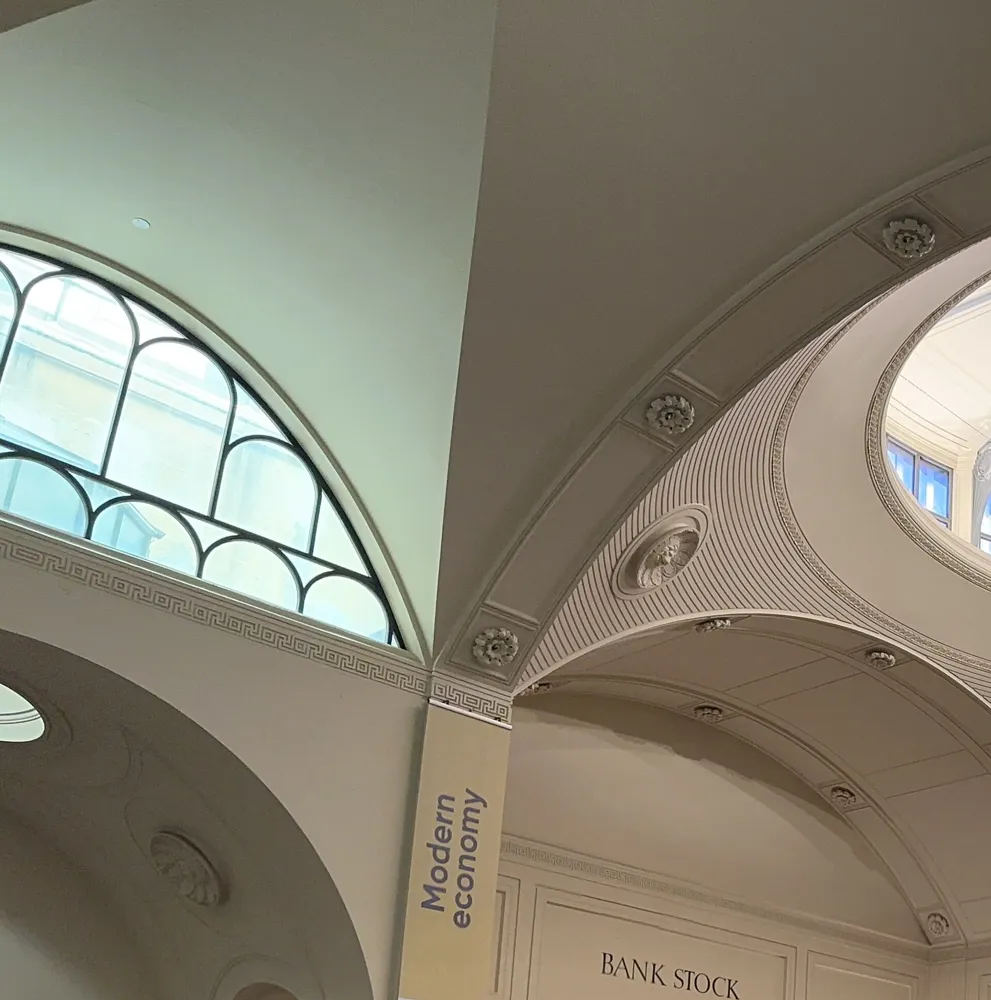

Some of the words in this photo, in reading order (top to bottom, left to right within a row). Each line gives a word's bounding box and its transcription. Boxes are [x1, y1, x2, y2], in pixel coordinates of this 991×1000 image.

[421, 794, 455, 912] Modern
[453, 788, 487, 928] economy
[601, 952, 667, 987] BANK
[673, 968, 740, 1000] STOCK
